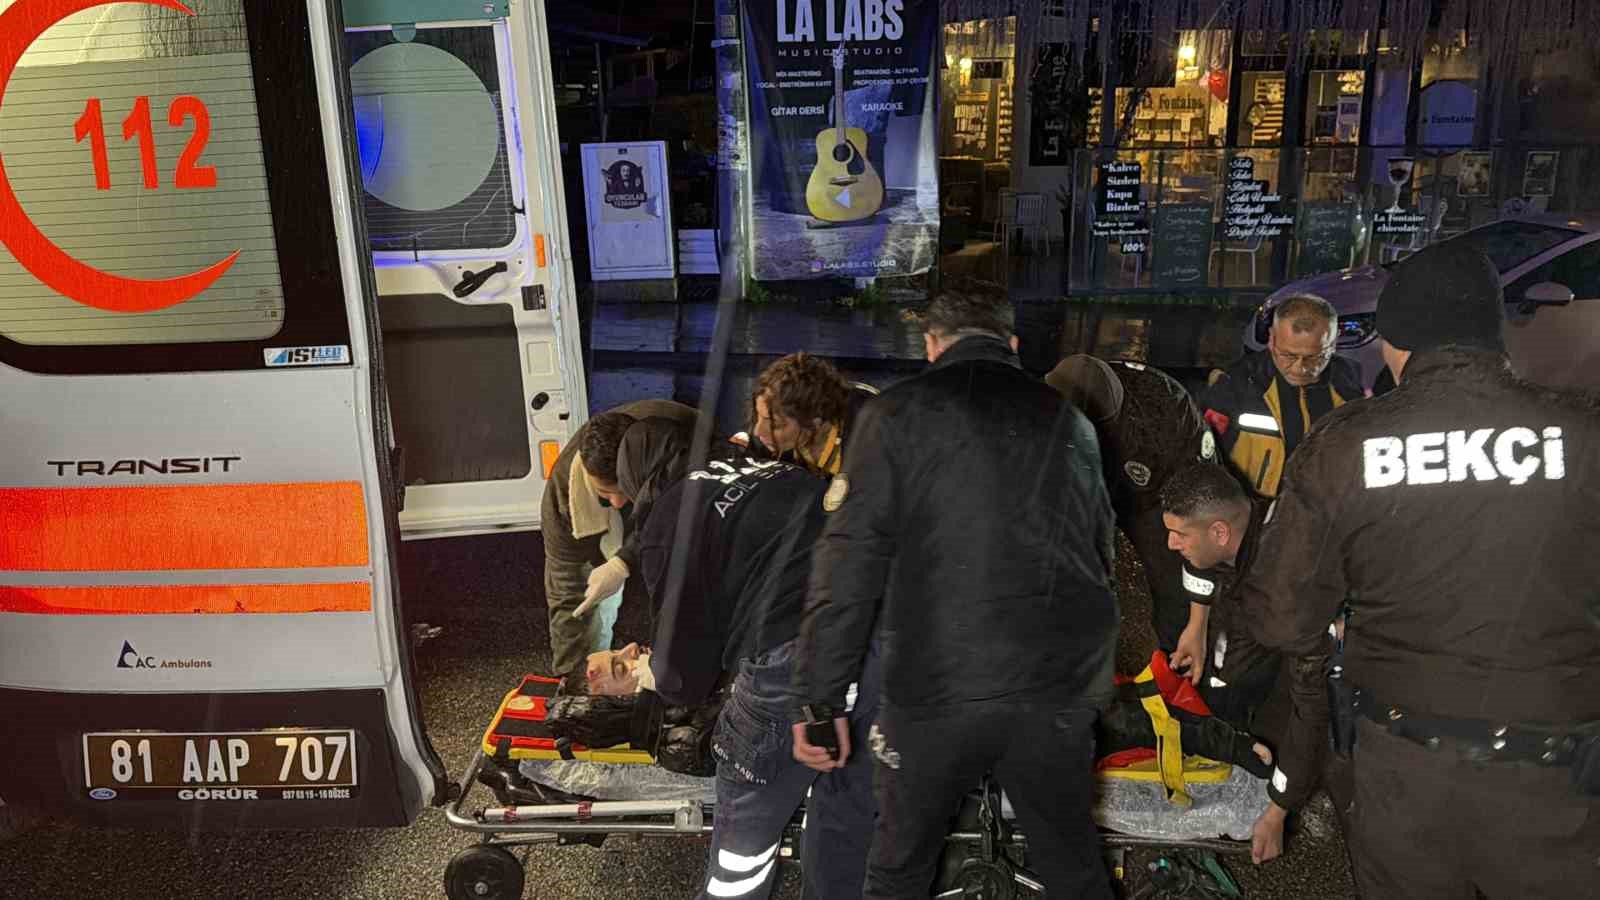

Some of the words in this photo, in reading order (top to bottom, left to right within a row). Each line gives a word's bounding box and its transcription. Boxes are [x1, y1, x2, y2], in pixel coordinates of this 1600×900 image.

[777, 0, 815, 42] LA
[826, 0, 904, 42] LABS
[771, 105, 798, 116] GİTAR
[799, 103, 825, 115] DERSİ
[861, 102, 904, 113] KARAOKE
[74, 95, 217, 190] 112
[1107, 176, 1140, 186] Sizden
[1106, 189, 1133, 201] Kupa
[1374, 213, 1386, 222] La
[1388, 213, 1426, 222] Fontaine
[1363, 426, 1565, 488] BEKÇİ
[48, 457, 241, 476] TRANSIT
[136, 657, 156, 668] AC
[160, 659, 212, 668] Ambulans
[111, 739, 153, 783] 81
[182, 738, 250, 783] AAP
[275, 736, 347, 782] 707
[178, 788, 258, 800] GÖRÜR
